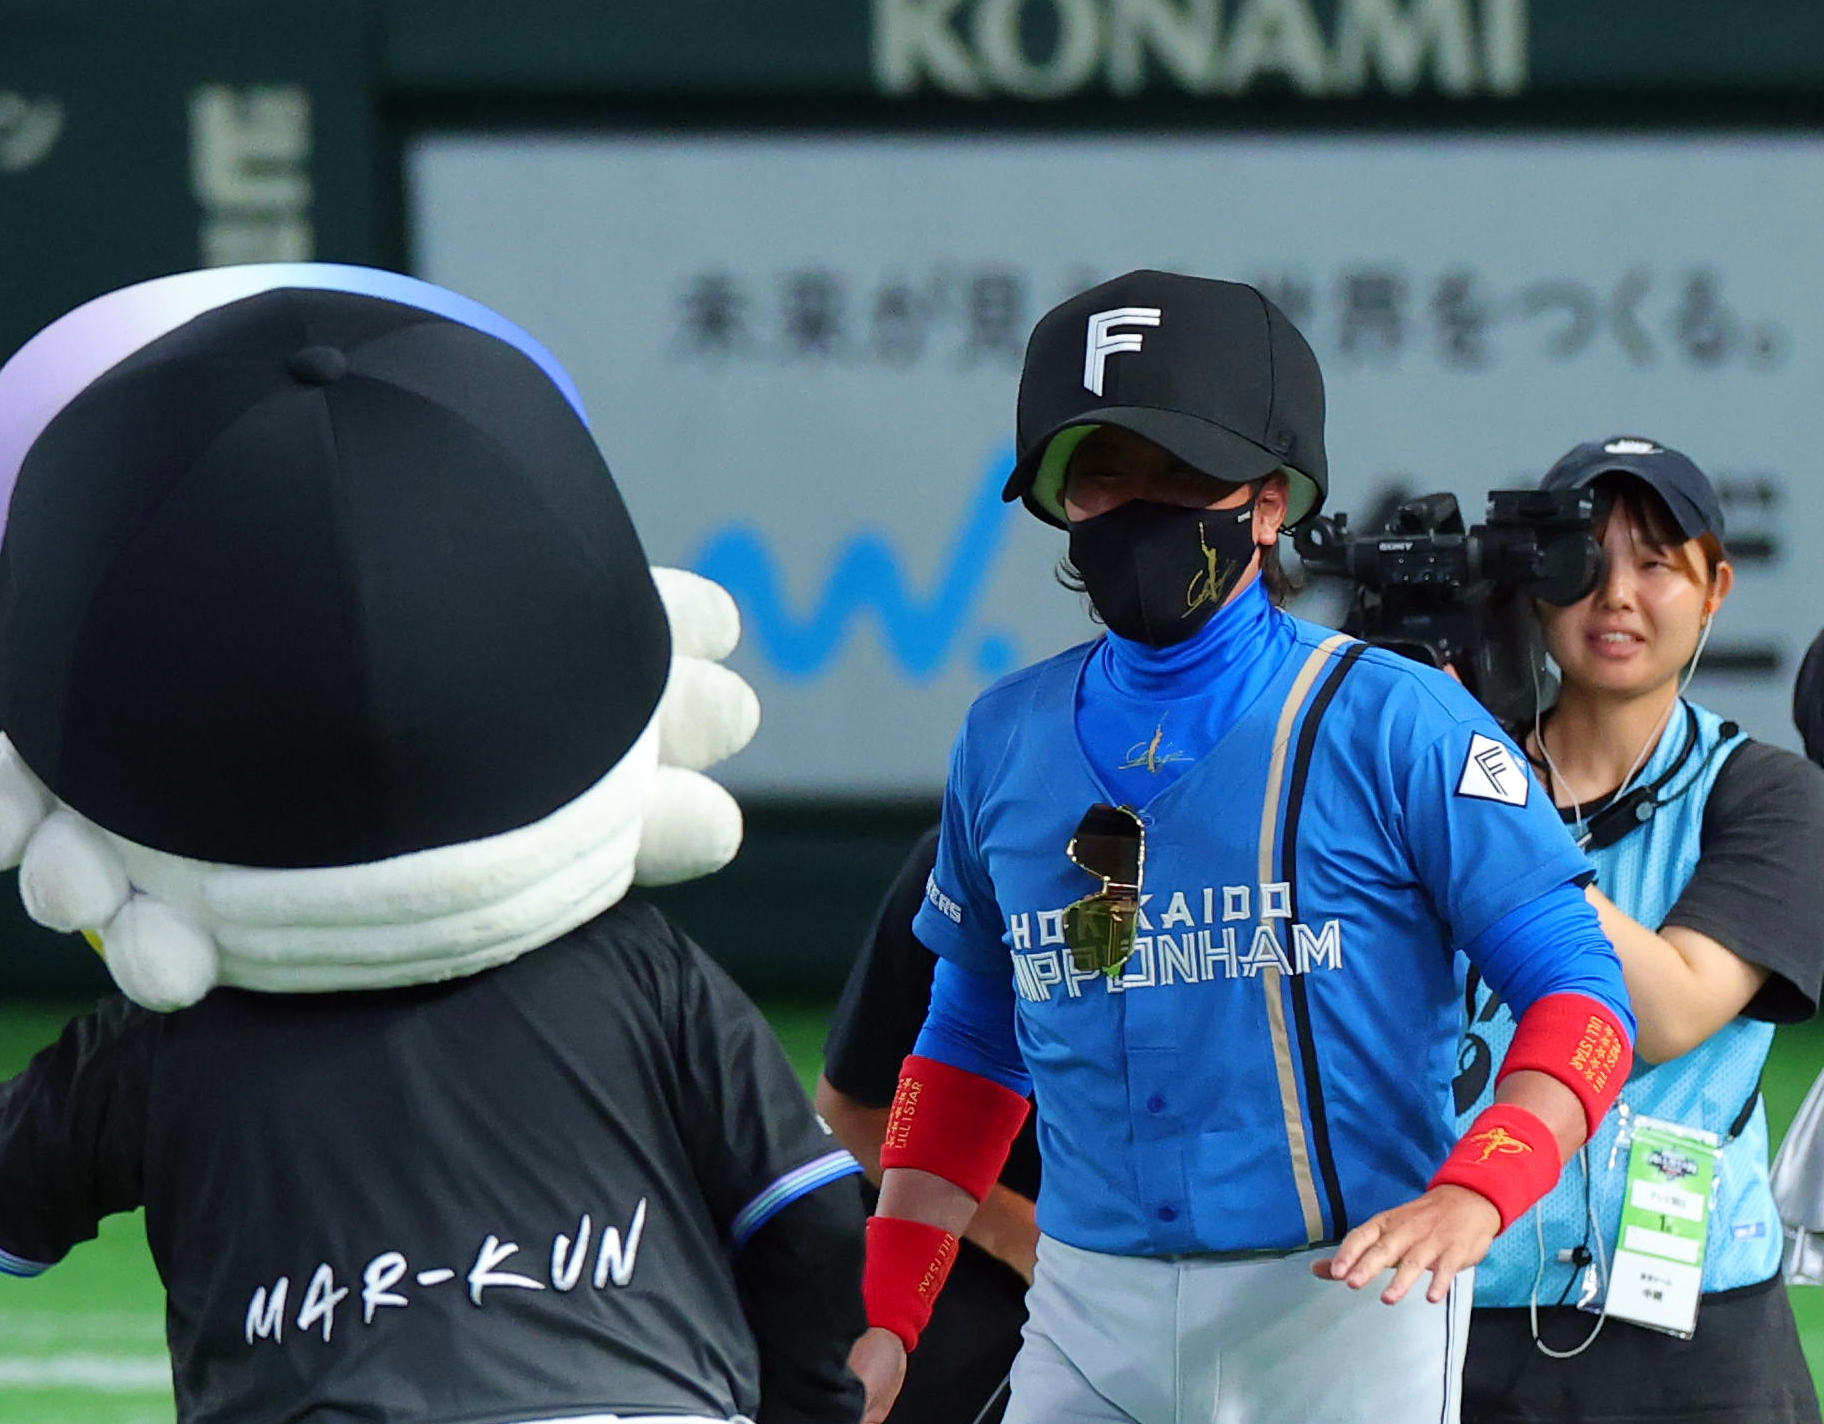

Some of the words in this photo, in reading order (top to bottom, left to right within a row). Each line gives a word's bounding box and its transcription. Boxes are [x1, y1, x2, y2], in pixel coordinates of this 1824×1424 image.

[871, 0, 1533, 97] KONAMI
[1083, 308, 1161, 397] F
[244, 1197, 647, 1345] MAR-KUN
